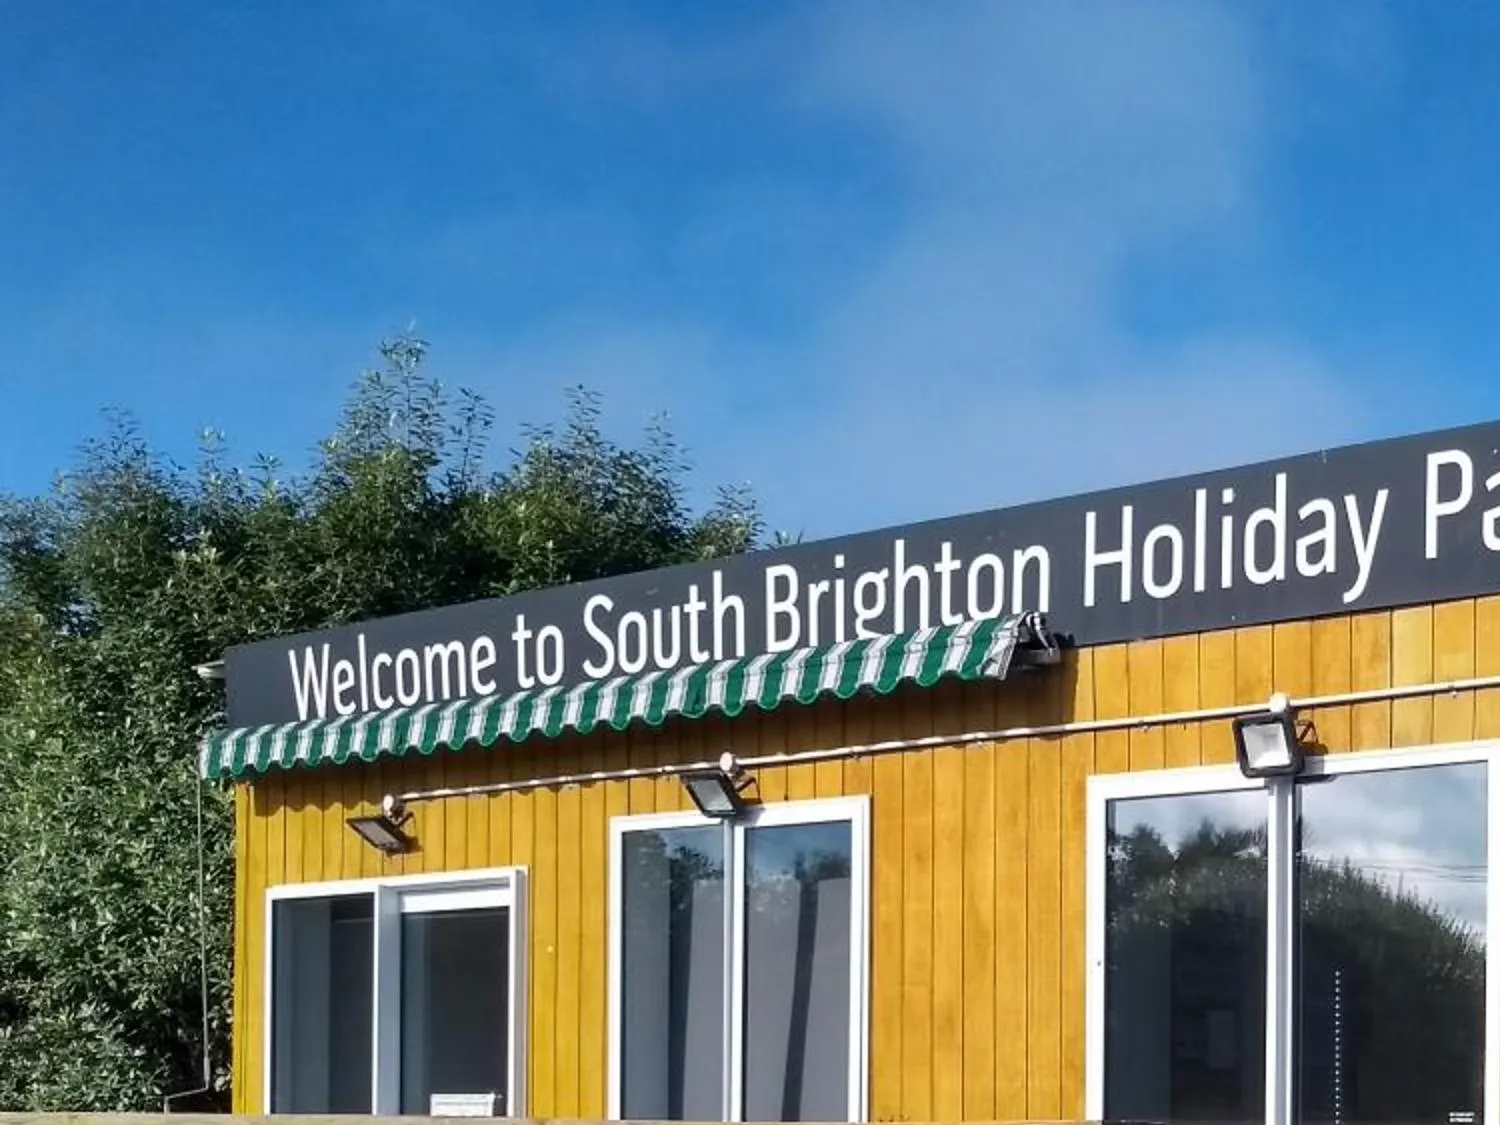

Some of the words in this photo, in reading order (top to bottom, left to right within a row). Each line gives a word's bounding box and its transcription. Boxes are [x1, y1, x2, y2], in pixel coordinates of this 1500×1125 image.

[288, 633, 496, 721] Welcome
[511, 613, 565, 689] to
[583, 569, 746, 679] South
[765, 539, 1050, 653] Brighton
[1083, 472, 1389, 604] Holiday
